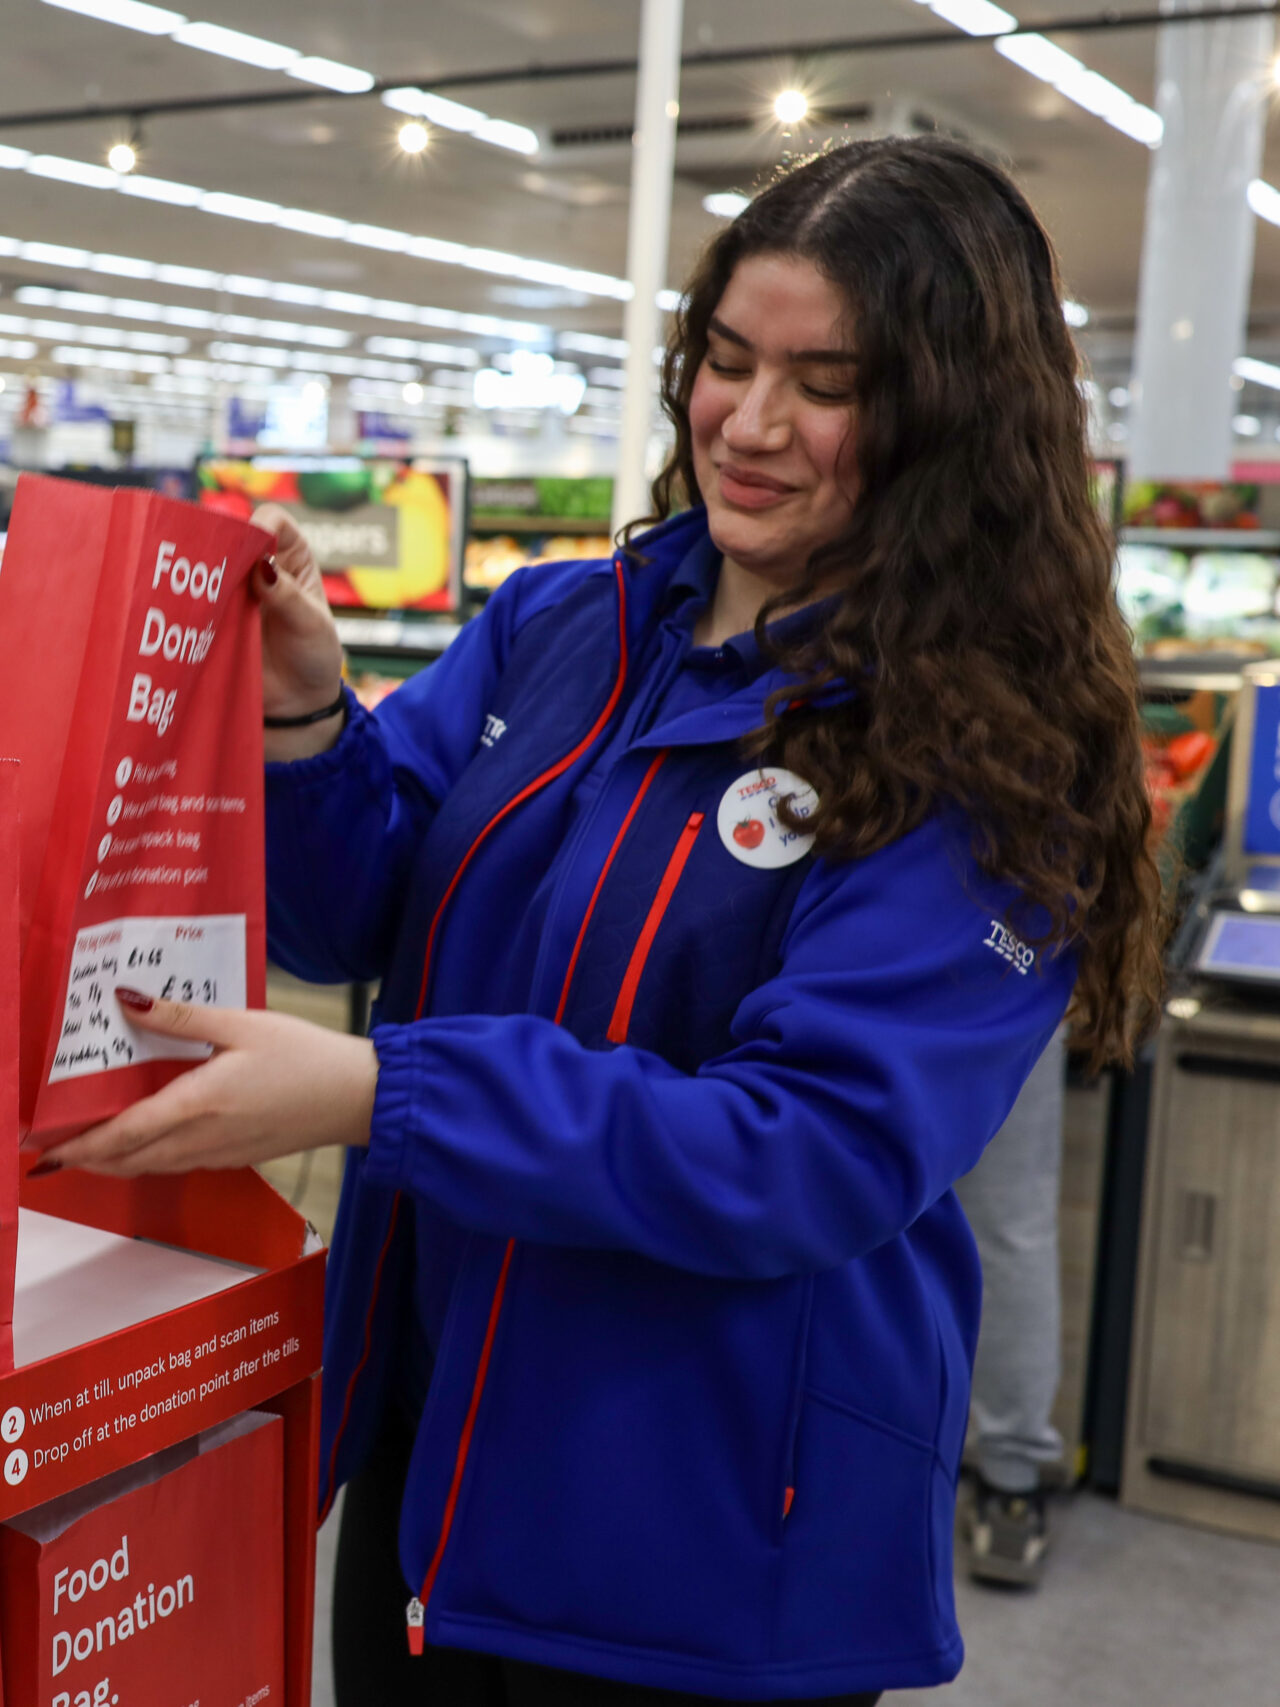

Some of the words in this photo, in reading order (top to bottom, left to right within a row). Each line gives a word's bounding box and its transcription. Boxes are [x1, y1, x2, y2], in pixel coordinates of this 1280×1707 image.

[151, 540, 227, 604] Food
[990, 920, 1034, 967] TESCO
[29, 1396, 72, 1426] When
[75, 1388, 90, 1408] at
[93, 1378, 114, 1401] till,
[118, 1357, 166, 1391] unpack
[169, 1349, 193, 1371] bag
[194, 1335, 217, 1359] and
[220, 1324, 247, 1349] scan
[249, 1311, 280, 1336] items
[33, 1441, 69, 1469] Drop
[73, 1428, 94, 1453] off
[96, 1423, 111, 1441] at
[114, 1409, 136, 1434] the
[140, 1388, 196, 1424] donation
[200, 1369, 230, 1399] point
[232, 1357, 260, 1382] after
[262, 1347, 281, 1368] the
[283, 1336, 300, 1357] tills
[53, 1535, 129, 1616] Food
[52, 1574, 194, 1677] Donation
